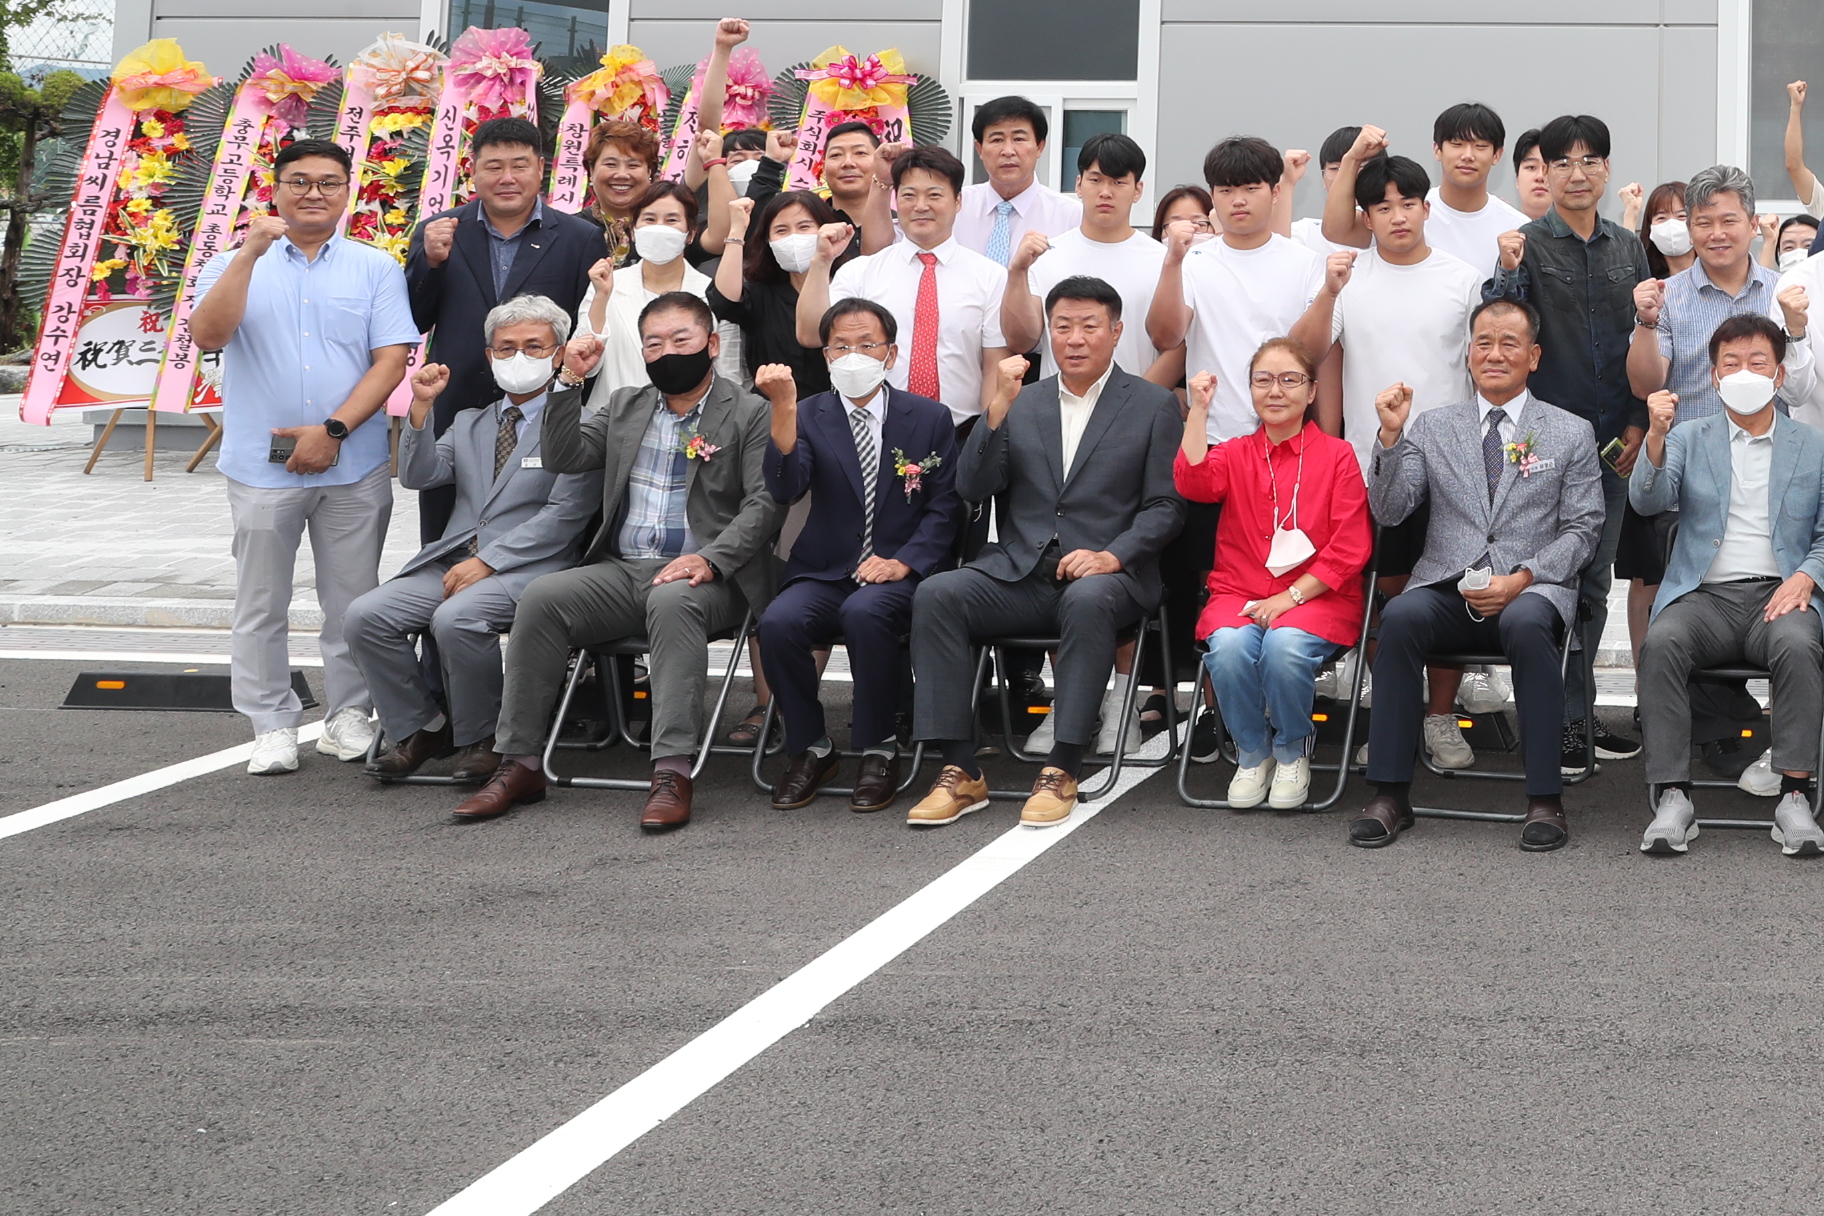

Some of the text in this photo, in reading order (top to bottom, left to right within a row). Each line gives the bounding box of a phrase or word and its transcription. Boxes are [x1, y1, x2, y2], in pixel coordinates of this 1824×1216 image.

[205, 117, 256, 217] 충무고등학교
[553, 122, 589, 205] 창원특례시
[39, 127, 123, 373] 경남씨름협회장 강수연
[137, 310, 165, 334] 祝
